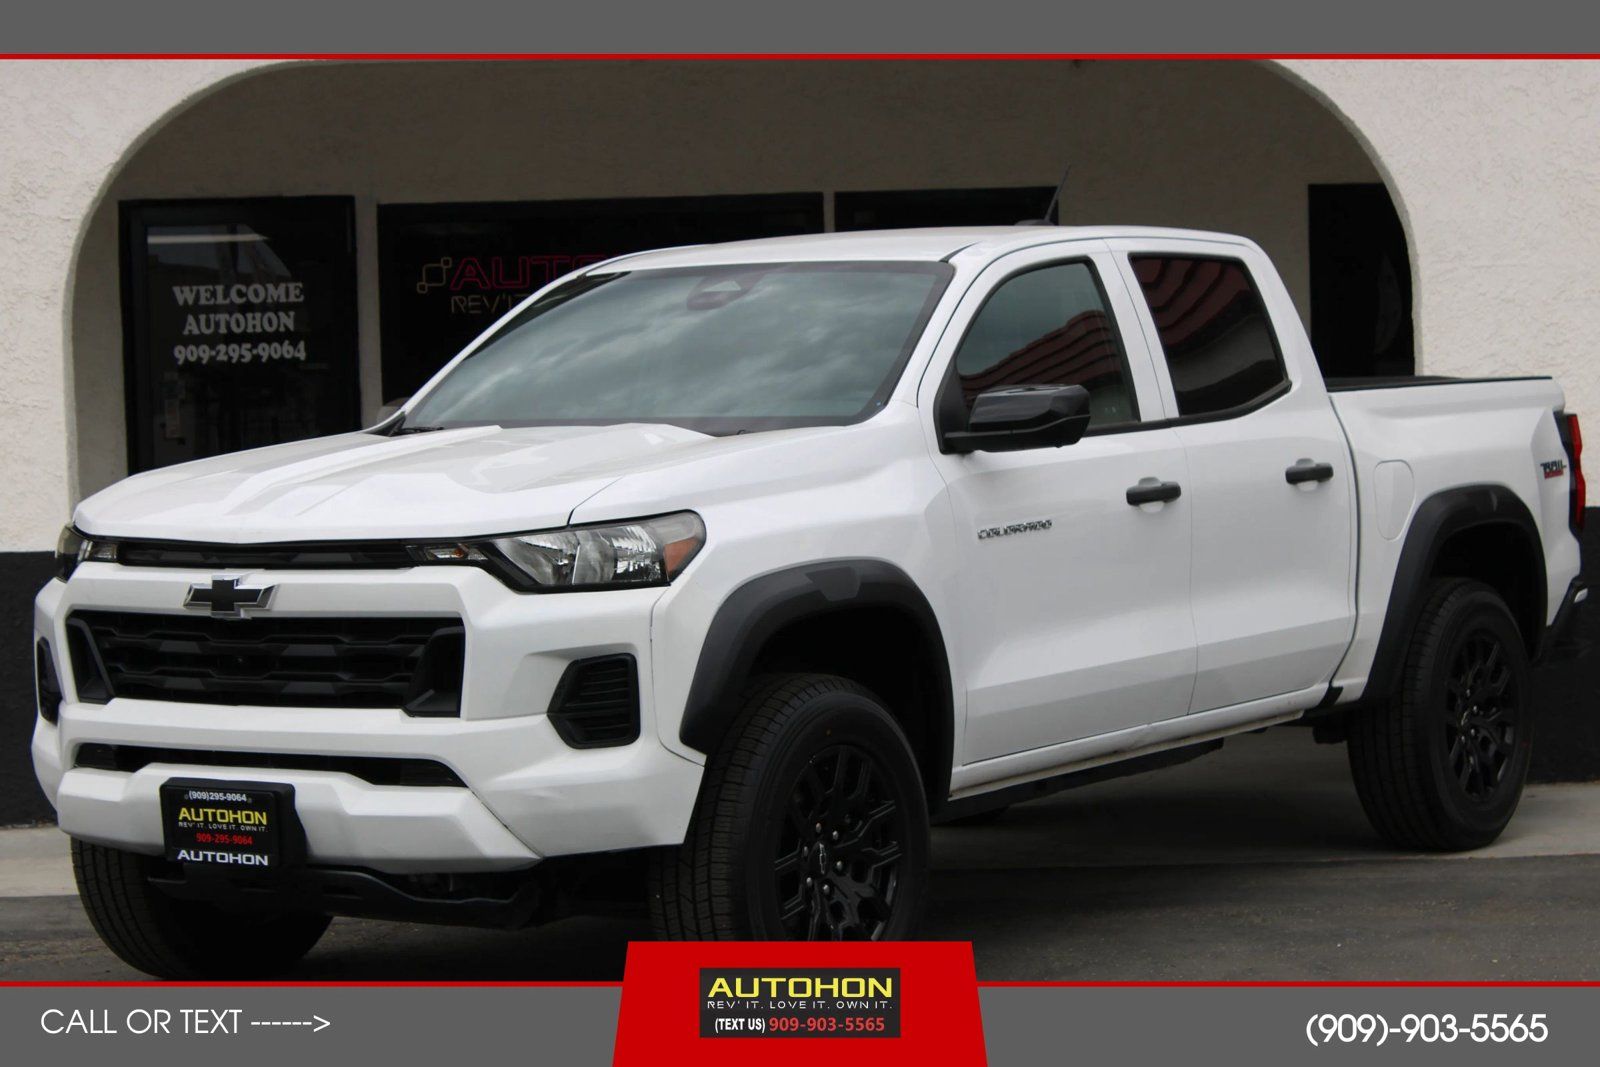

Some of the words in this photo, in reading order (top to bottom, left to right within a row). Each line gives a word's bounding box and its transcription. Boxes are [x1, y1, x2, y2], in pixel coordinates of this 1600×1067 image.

[172, 282, 304, 306] WELCOME
[182, 311, 296, 335] AUTOHON
[173, 340, 306, 365] 909-295-9064
[178, 807, 267, 825] AUTOHON
[195, 832, 253, 845] 909-295-9064
[177, 850, 269, 866] AUTOHON
